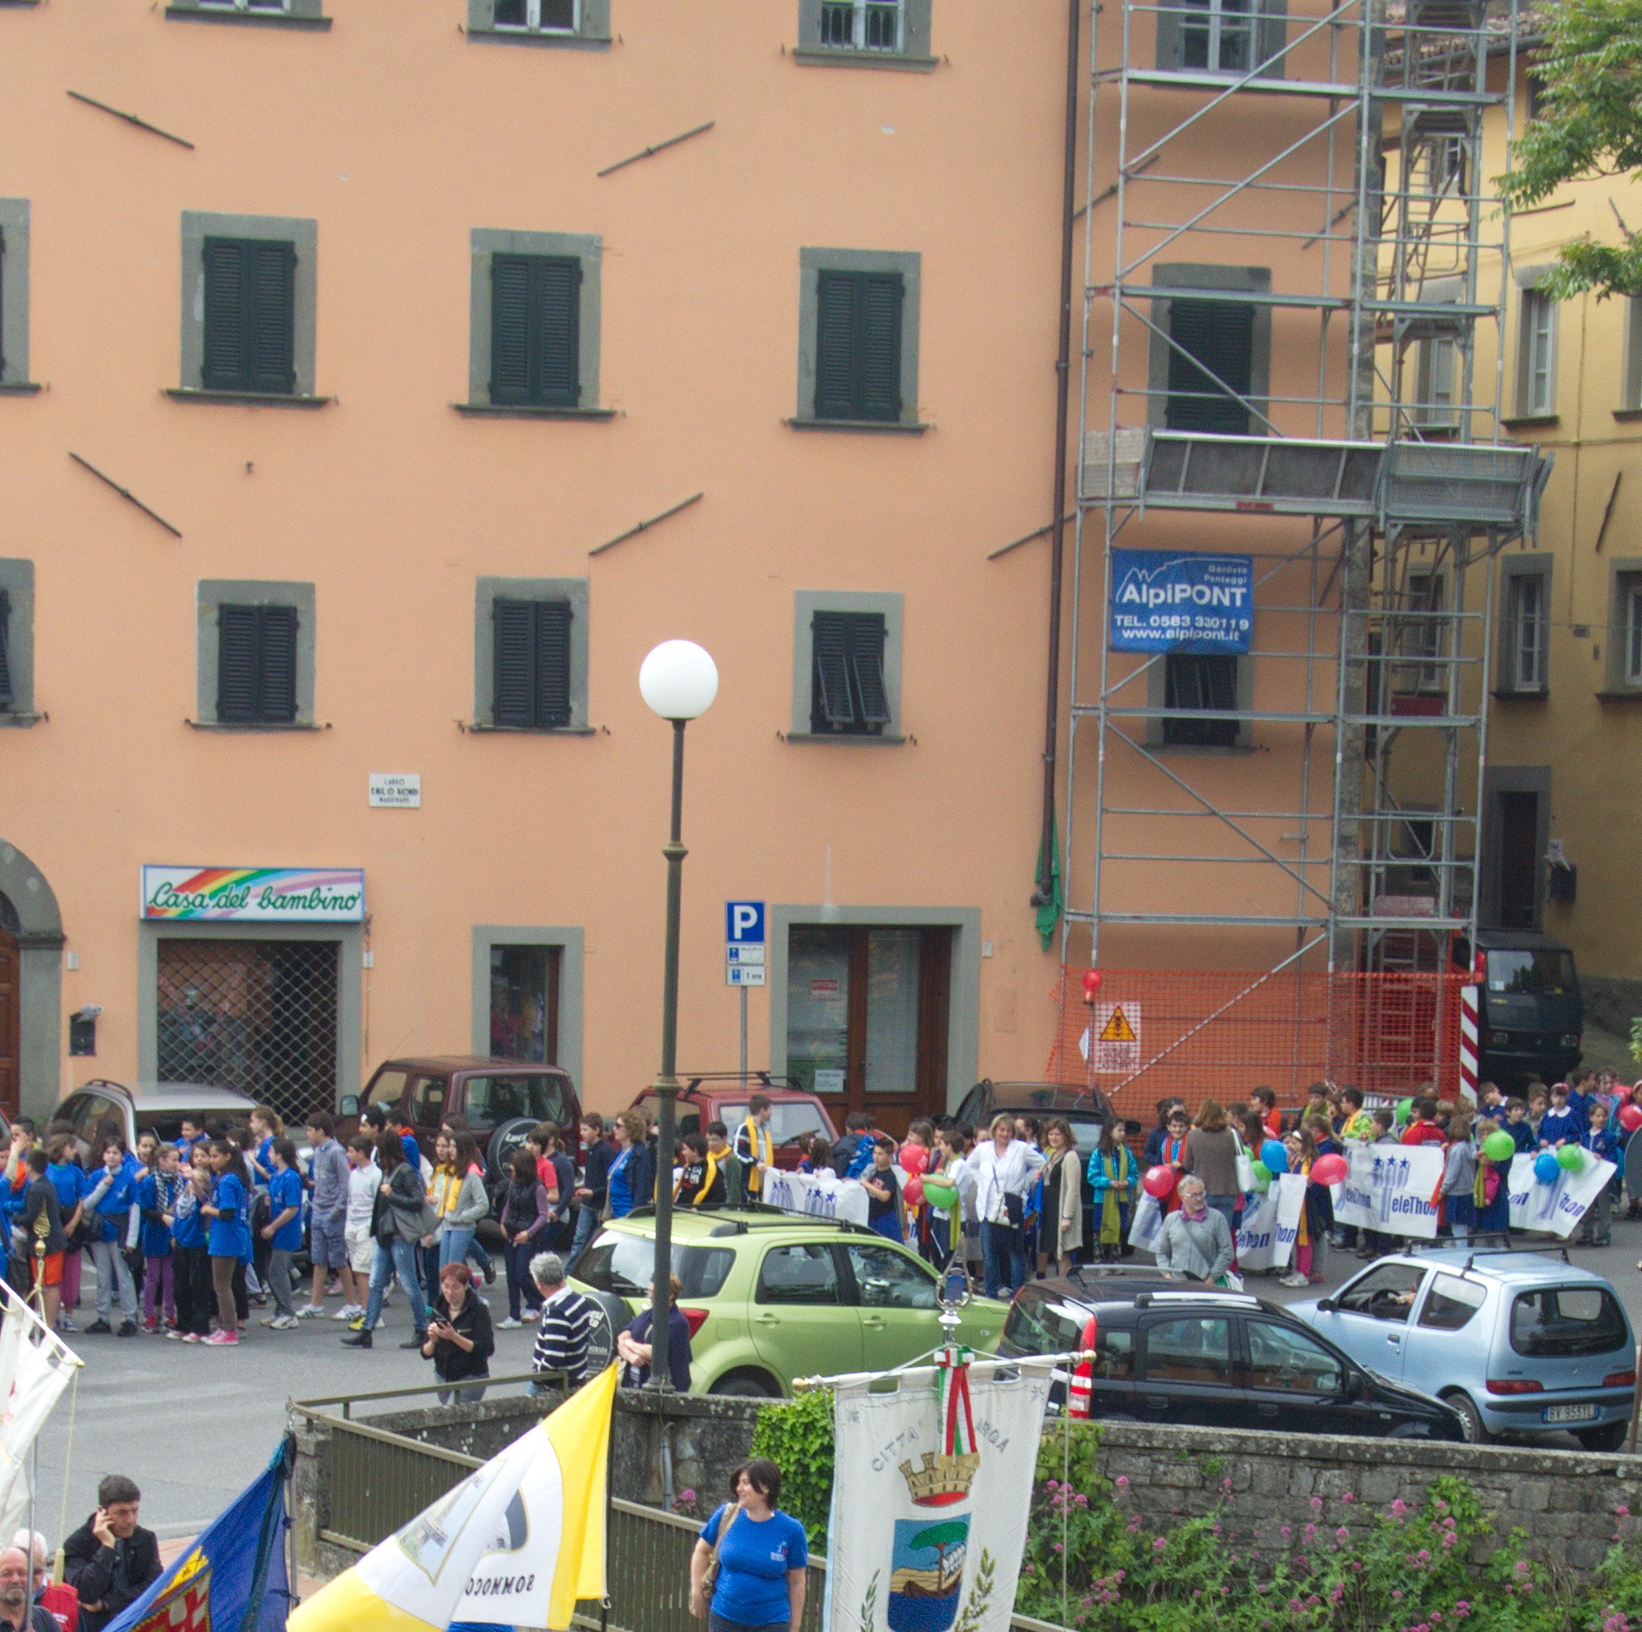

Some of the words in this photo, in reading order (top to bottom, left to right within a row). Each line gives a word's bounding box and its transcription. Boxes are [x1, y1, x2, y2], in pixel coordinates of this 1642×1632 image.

[1121, 583, 1247, 608] AlpiPONT
[1114, 615, 1147, 627] TEL.
[1150, 615, 1191, 627] 0583
[1195, 616, 1250, 631] 330119
[149, 881, 208, 908] Casa
[210, 884, 249, 909] del
[256, 885, 361, 911] bambino
[733, 905, 758, 940] P
